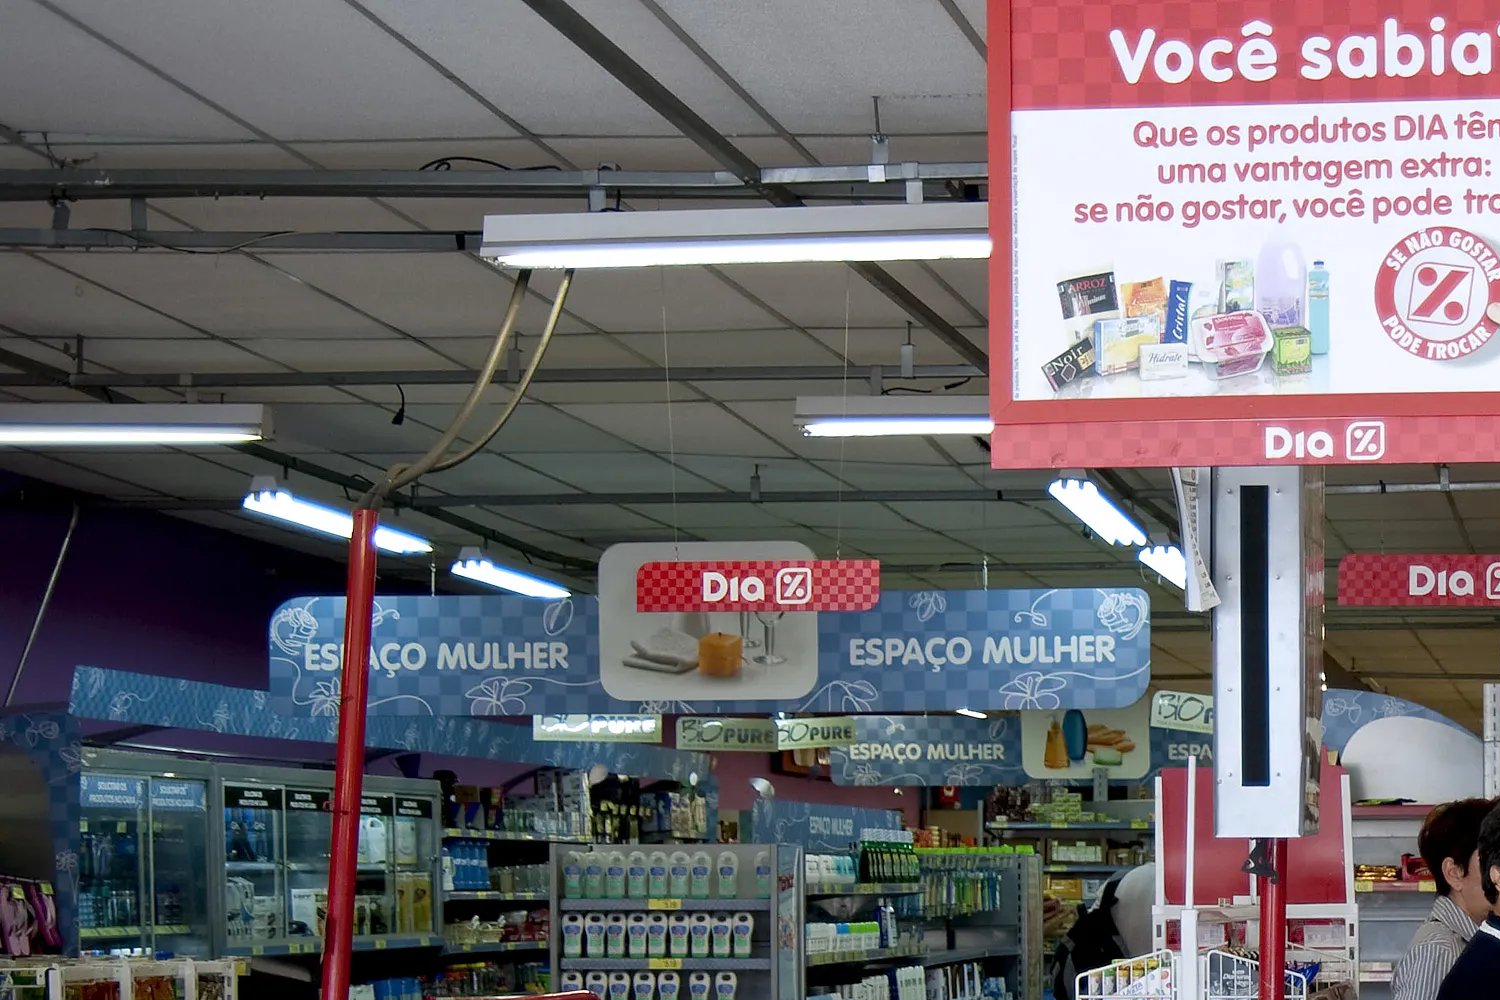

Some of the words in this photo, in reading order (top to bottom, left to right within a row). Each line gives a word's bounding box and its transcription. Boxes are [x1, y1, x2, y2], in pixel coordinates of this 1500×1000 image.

[1108, 20, 1278, 85] Você
[1132, 119, 1198, 150] Que
[1207, 123, 1240, 146] os
[1247, 115, 1386, 153] produtos
[1394, 114, 1447, 141] DIA
[1157, 160, 1227, 184] uma
[1233, 153, 1393, 189] vantagem
[1400, 154, 1492, 180] extra:
[1074, 200, 1108, 225] se
[1115, 194, 1174, 223] não
[1181, 194, 1285, 228] gostar,
[1293, 189, 1365, 218] você
[1372, 188, 1452, 223] pode
[1386, 249, 1408, 271] SE
[1404, 228, 1443, 253] NÃO
[1069, 277, 1107, 292] ARROZ
[1382, 315, 1423, 353] PODE
[1051, 345, 1084, 371] Noir
[304, 642, 427, 678] ESAÇO
[437, 642, 569, 671] MULHER
[849, 637, 972, 672] ESPAÇO
[982, 635, 1116, 664] MULHER
[723, 728, 775, 744] PURE
[809, 725, 853, 740] PURE
[849, 742, 922, 764] ESPAÇO
[926, 742, 1005, 761] MULHER
